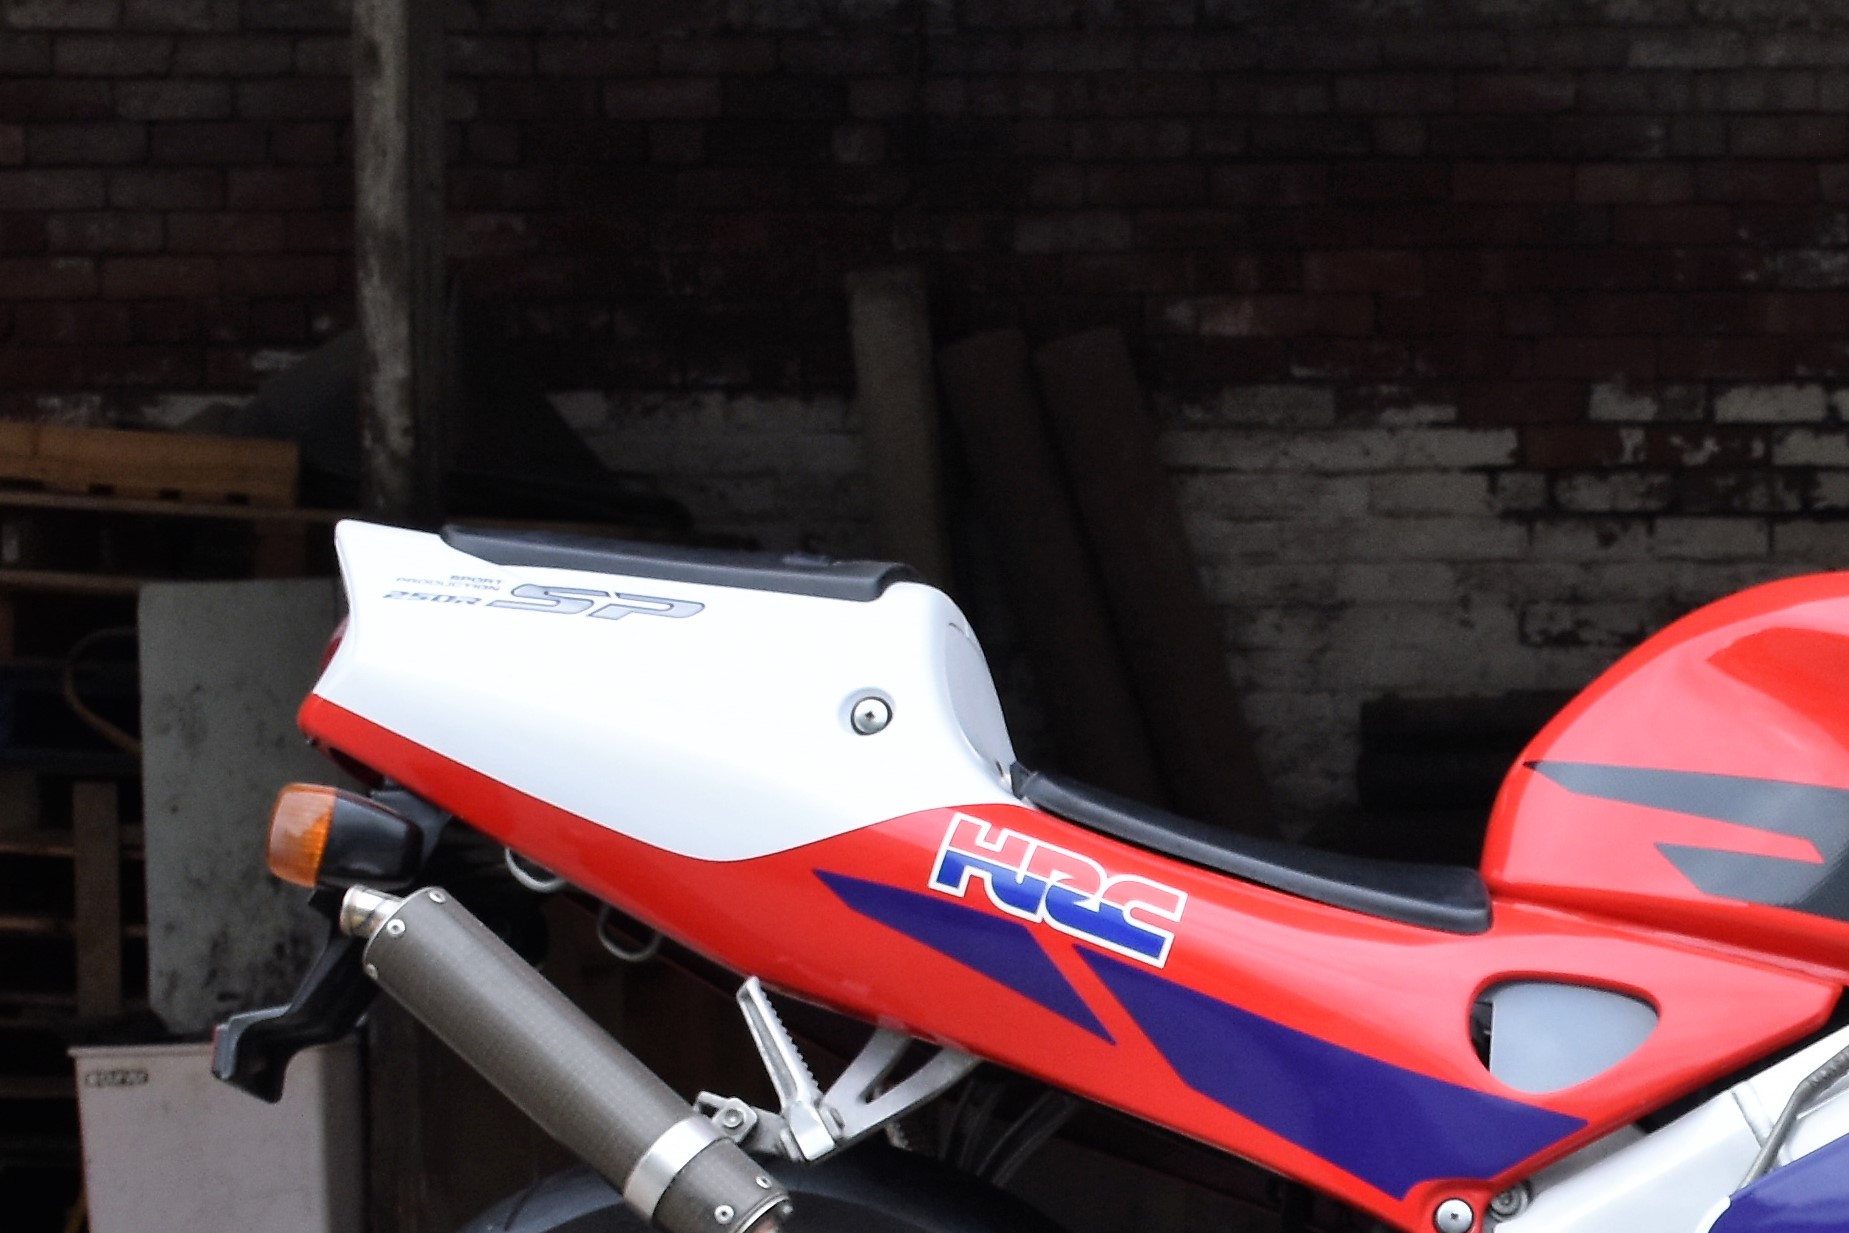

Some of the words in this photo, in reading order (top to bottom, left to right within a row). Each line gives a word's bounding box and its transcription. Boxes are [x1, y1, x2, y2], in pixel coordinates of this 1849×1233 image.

[395, 577, 501, 591] PRODUCTION
[449, 574, 504, 585] SPORT
[382, 590, 483, 605] 250R
[485, 583, 705, 620] SP
[928, 812, 1188, 968] HRC
